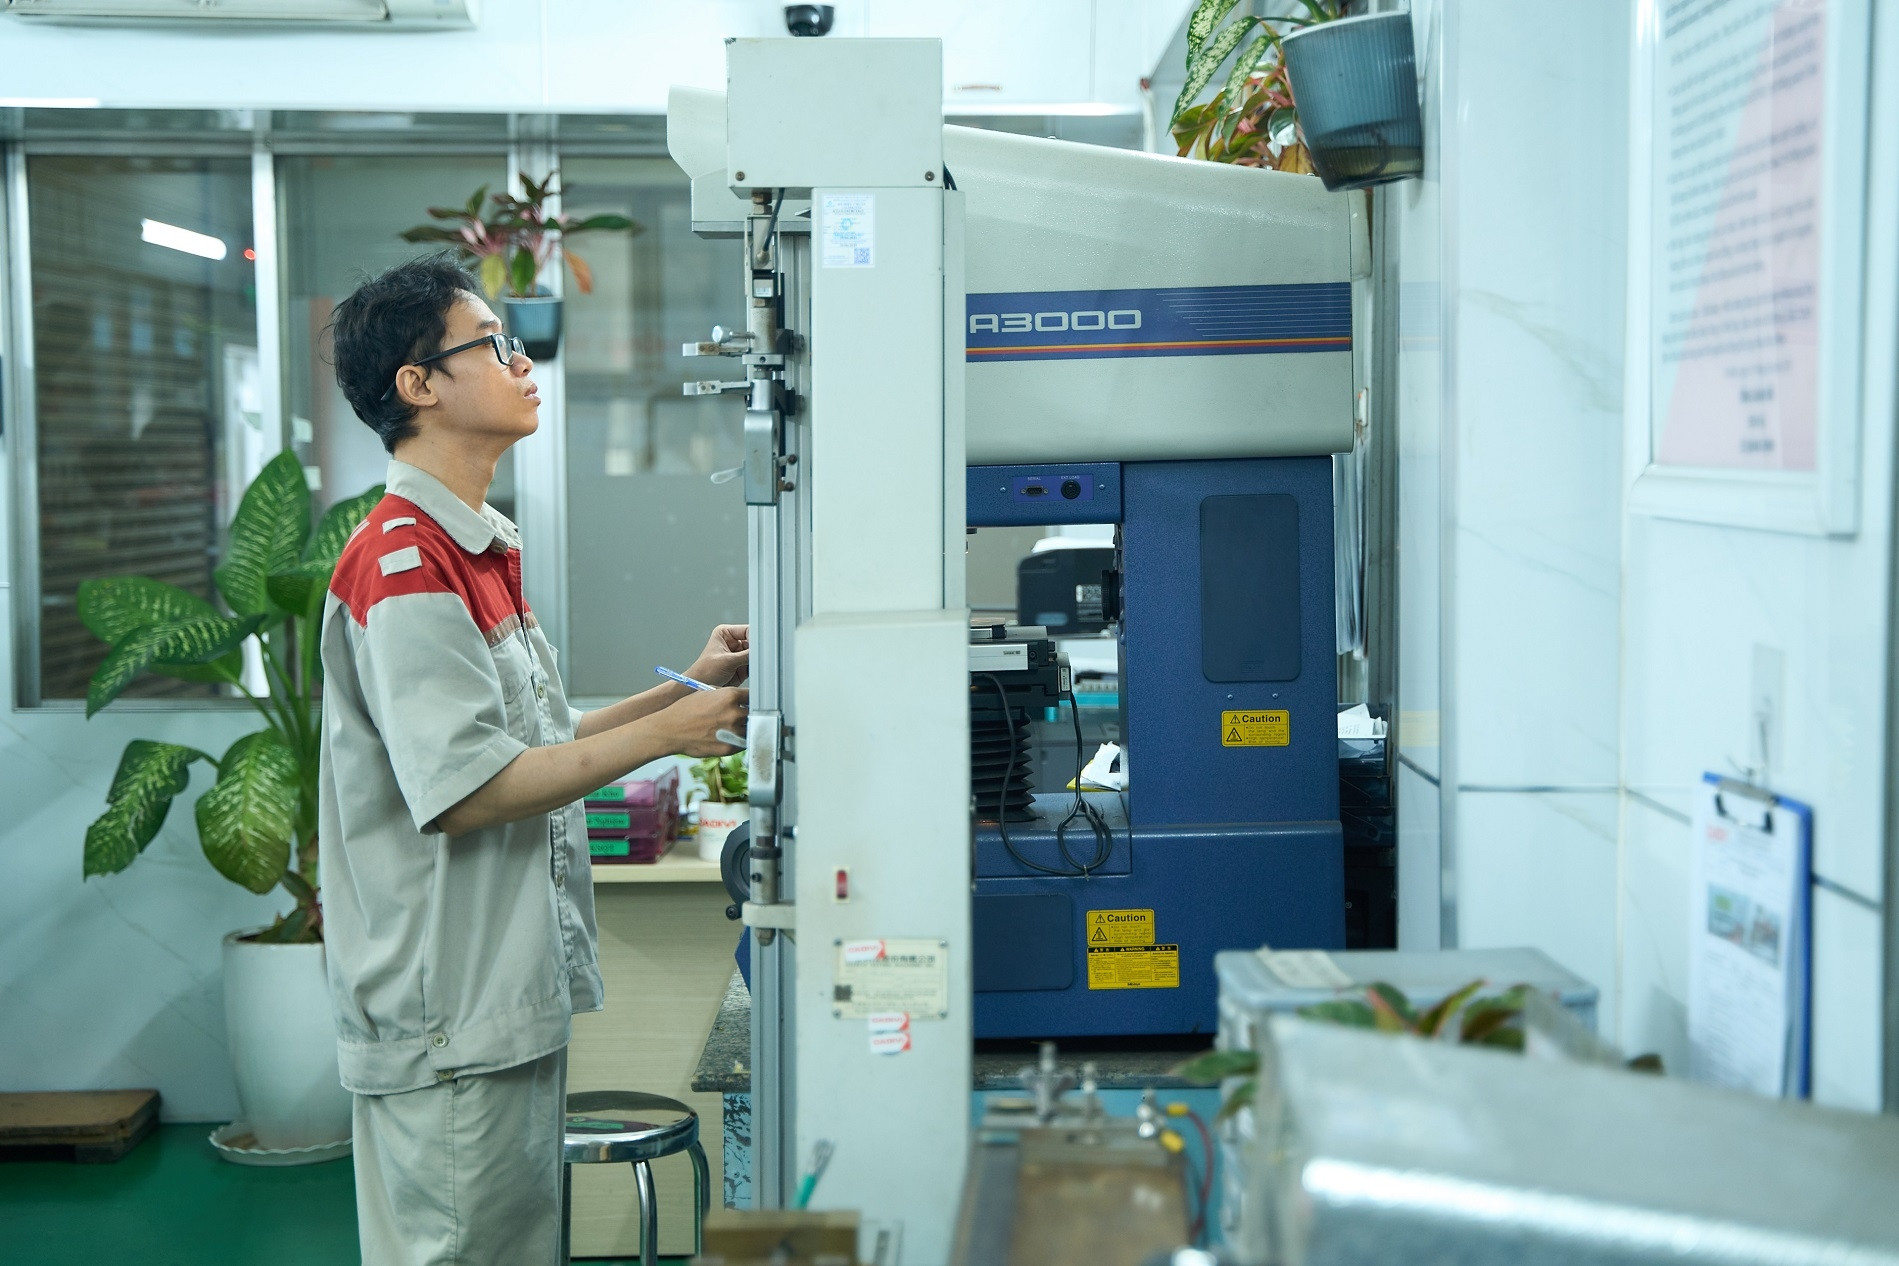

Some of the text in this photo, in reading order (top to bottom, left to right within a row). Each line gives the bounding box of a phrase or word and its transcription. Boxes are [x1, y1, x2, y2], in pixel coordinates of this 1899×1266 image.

[969, 309, 1142, 334] A3000
[1242, 714, 1281, 723] Caution
[1107, 913, 1146, 923] Caution
